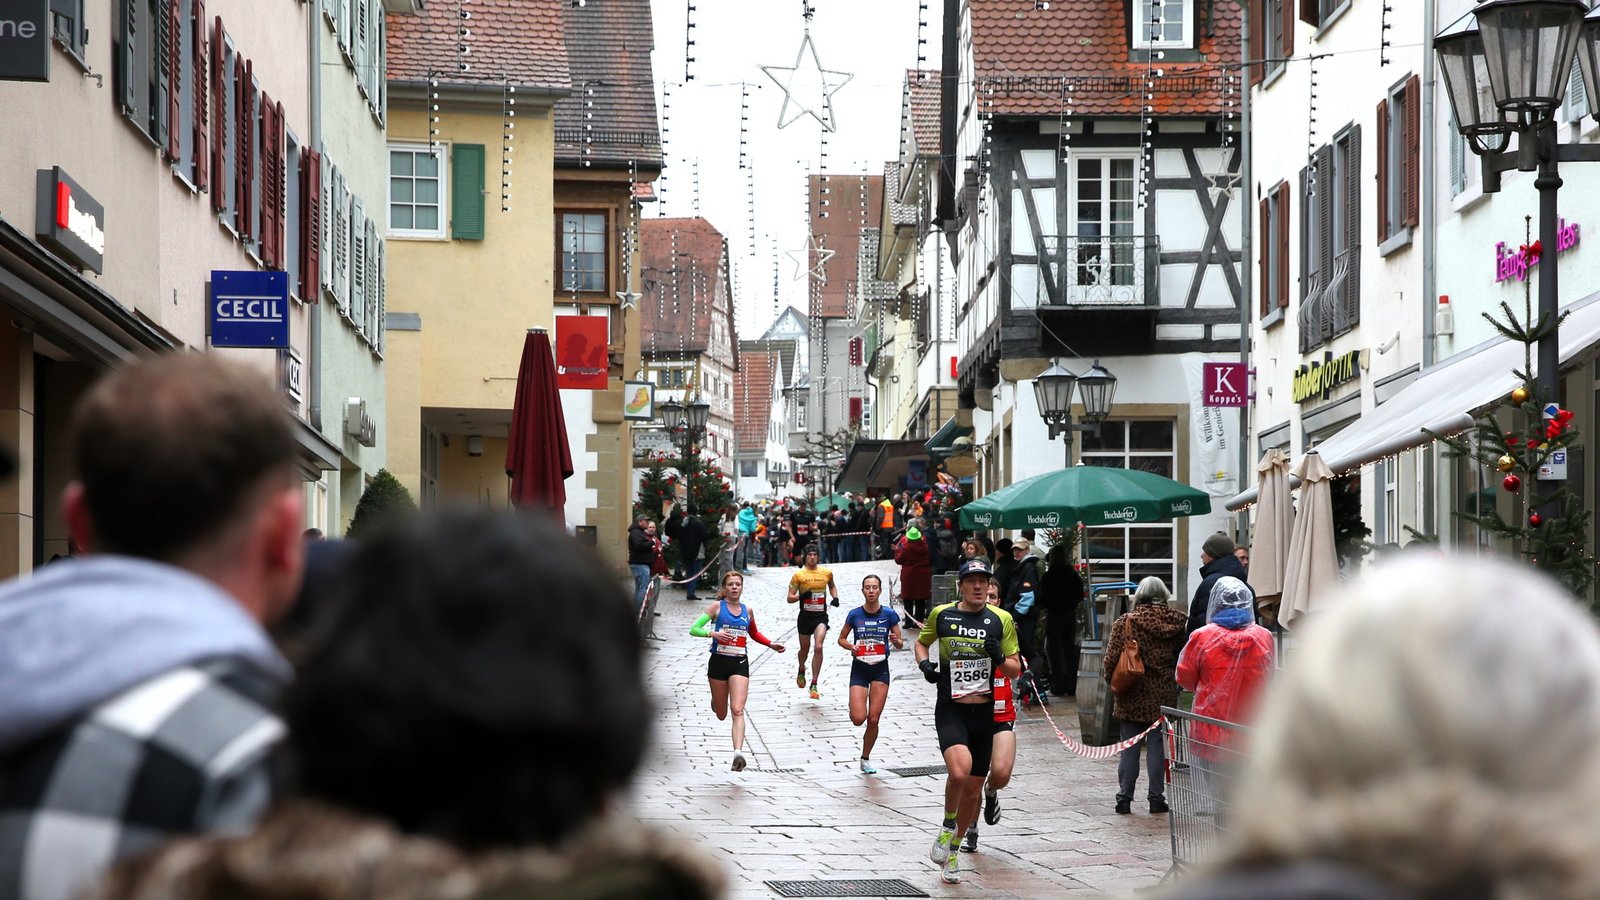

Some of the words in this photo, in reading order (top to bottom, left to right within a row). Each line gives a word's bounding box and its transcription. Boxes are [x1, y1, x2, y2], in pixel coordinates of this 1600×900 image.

[216, 300, 282, 318] CECIL
[1214, 367, 1237, 393] K
[1209, 394, 1242, 405] Koppe's
[1203, 407, 1213, 443] Willkom
[1212, 407, 1224, 437] Genieß
[1027, 513, 1057, 525] Hochdorfer
[1104, 508, 1134, 520] Hochdorfer
[958, 625, 986, 640] hep
[954, 668, 989, 682] 2586
